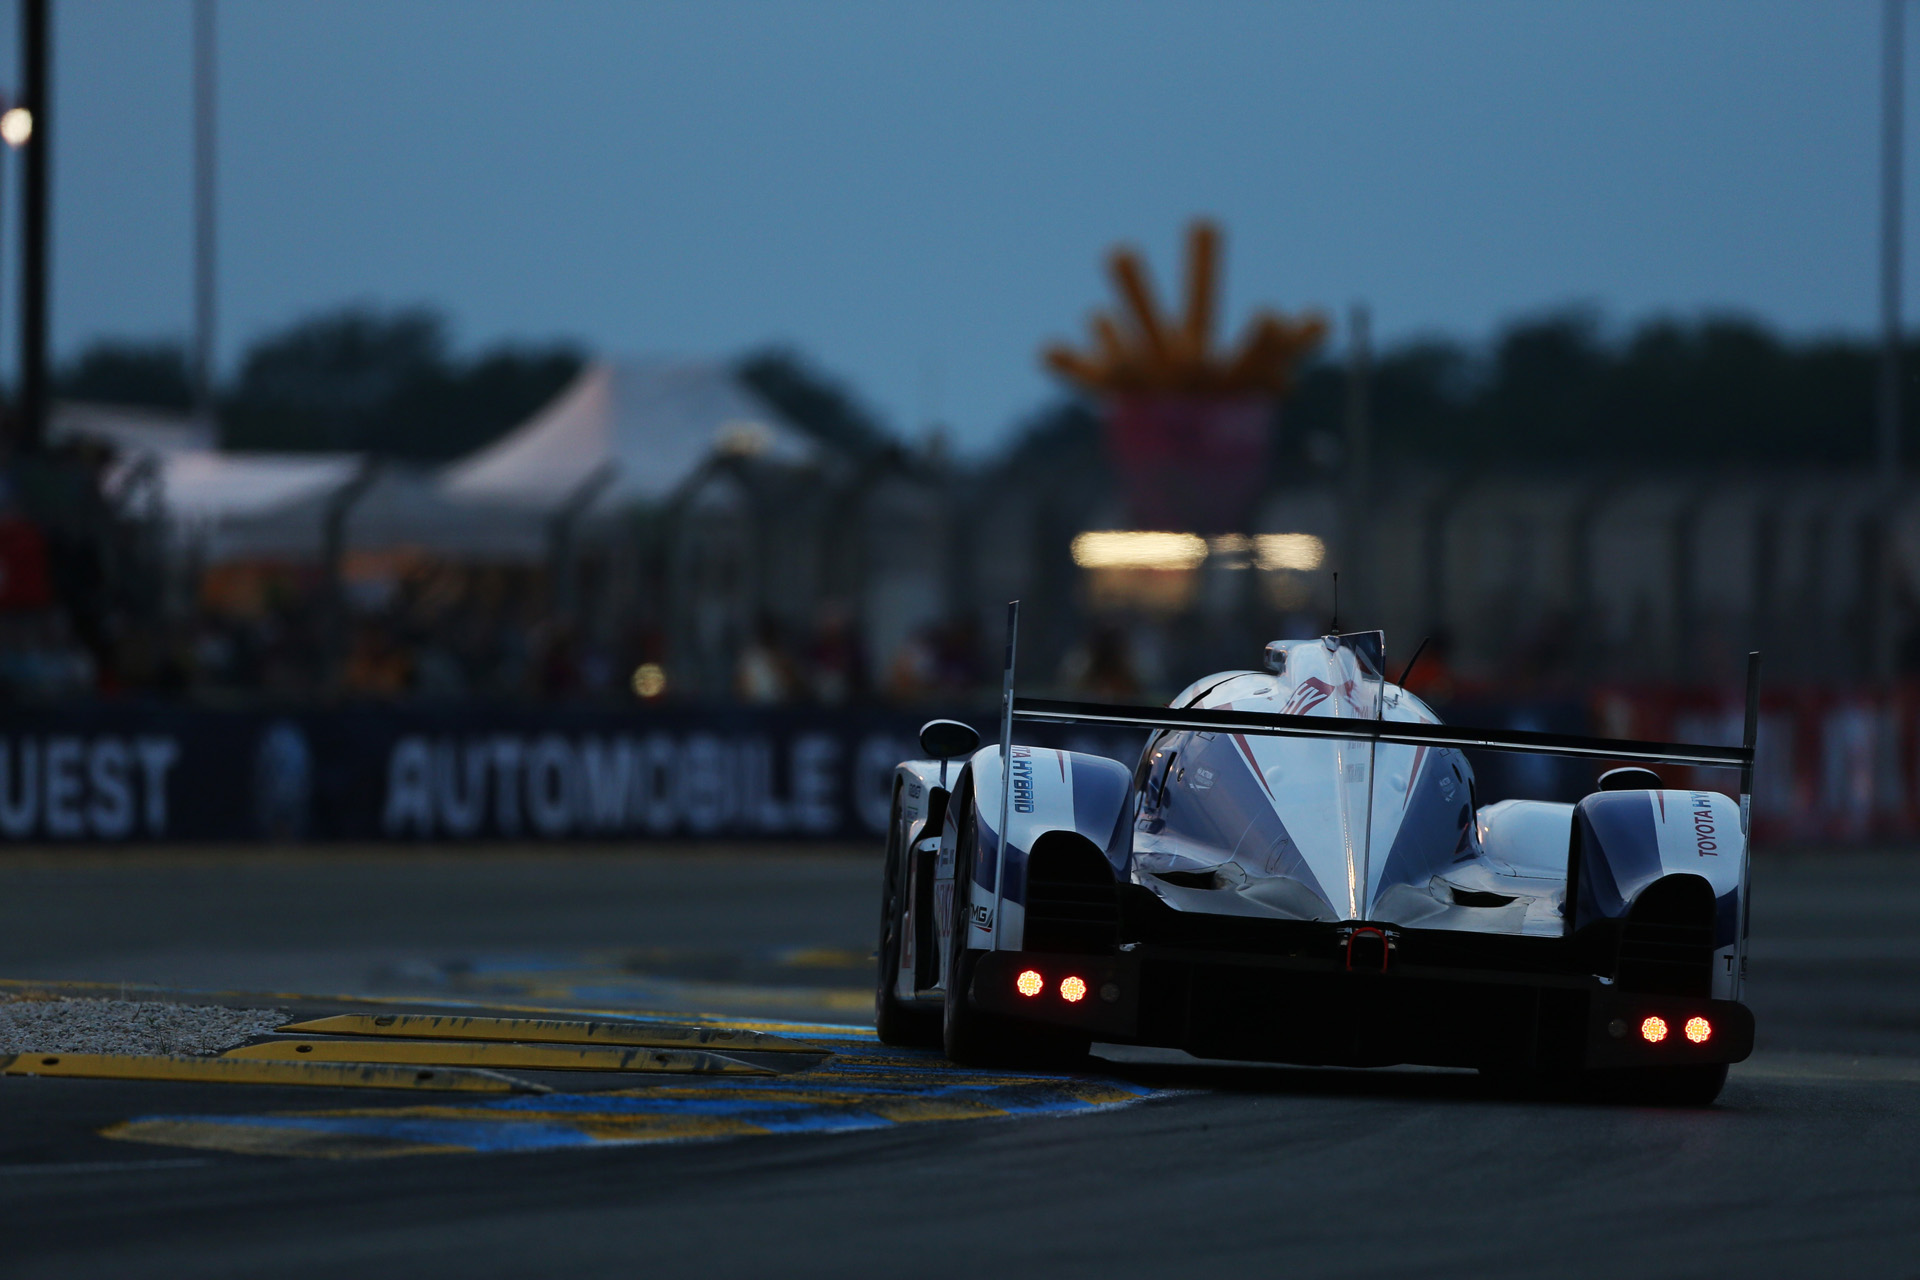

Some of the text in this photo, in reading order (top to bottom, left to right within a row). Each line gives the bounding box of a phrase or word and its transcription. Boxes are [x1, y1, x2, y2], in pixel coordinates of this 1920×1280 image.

[384, 732, 842, 838] AUTOMOBILE
[1013, 760, 1034, 813] HYBRID
[1694, 810, 1718, 857] TOYOTA
[970, 903, 988, 923] MG
